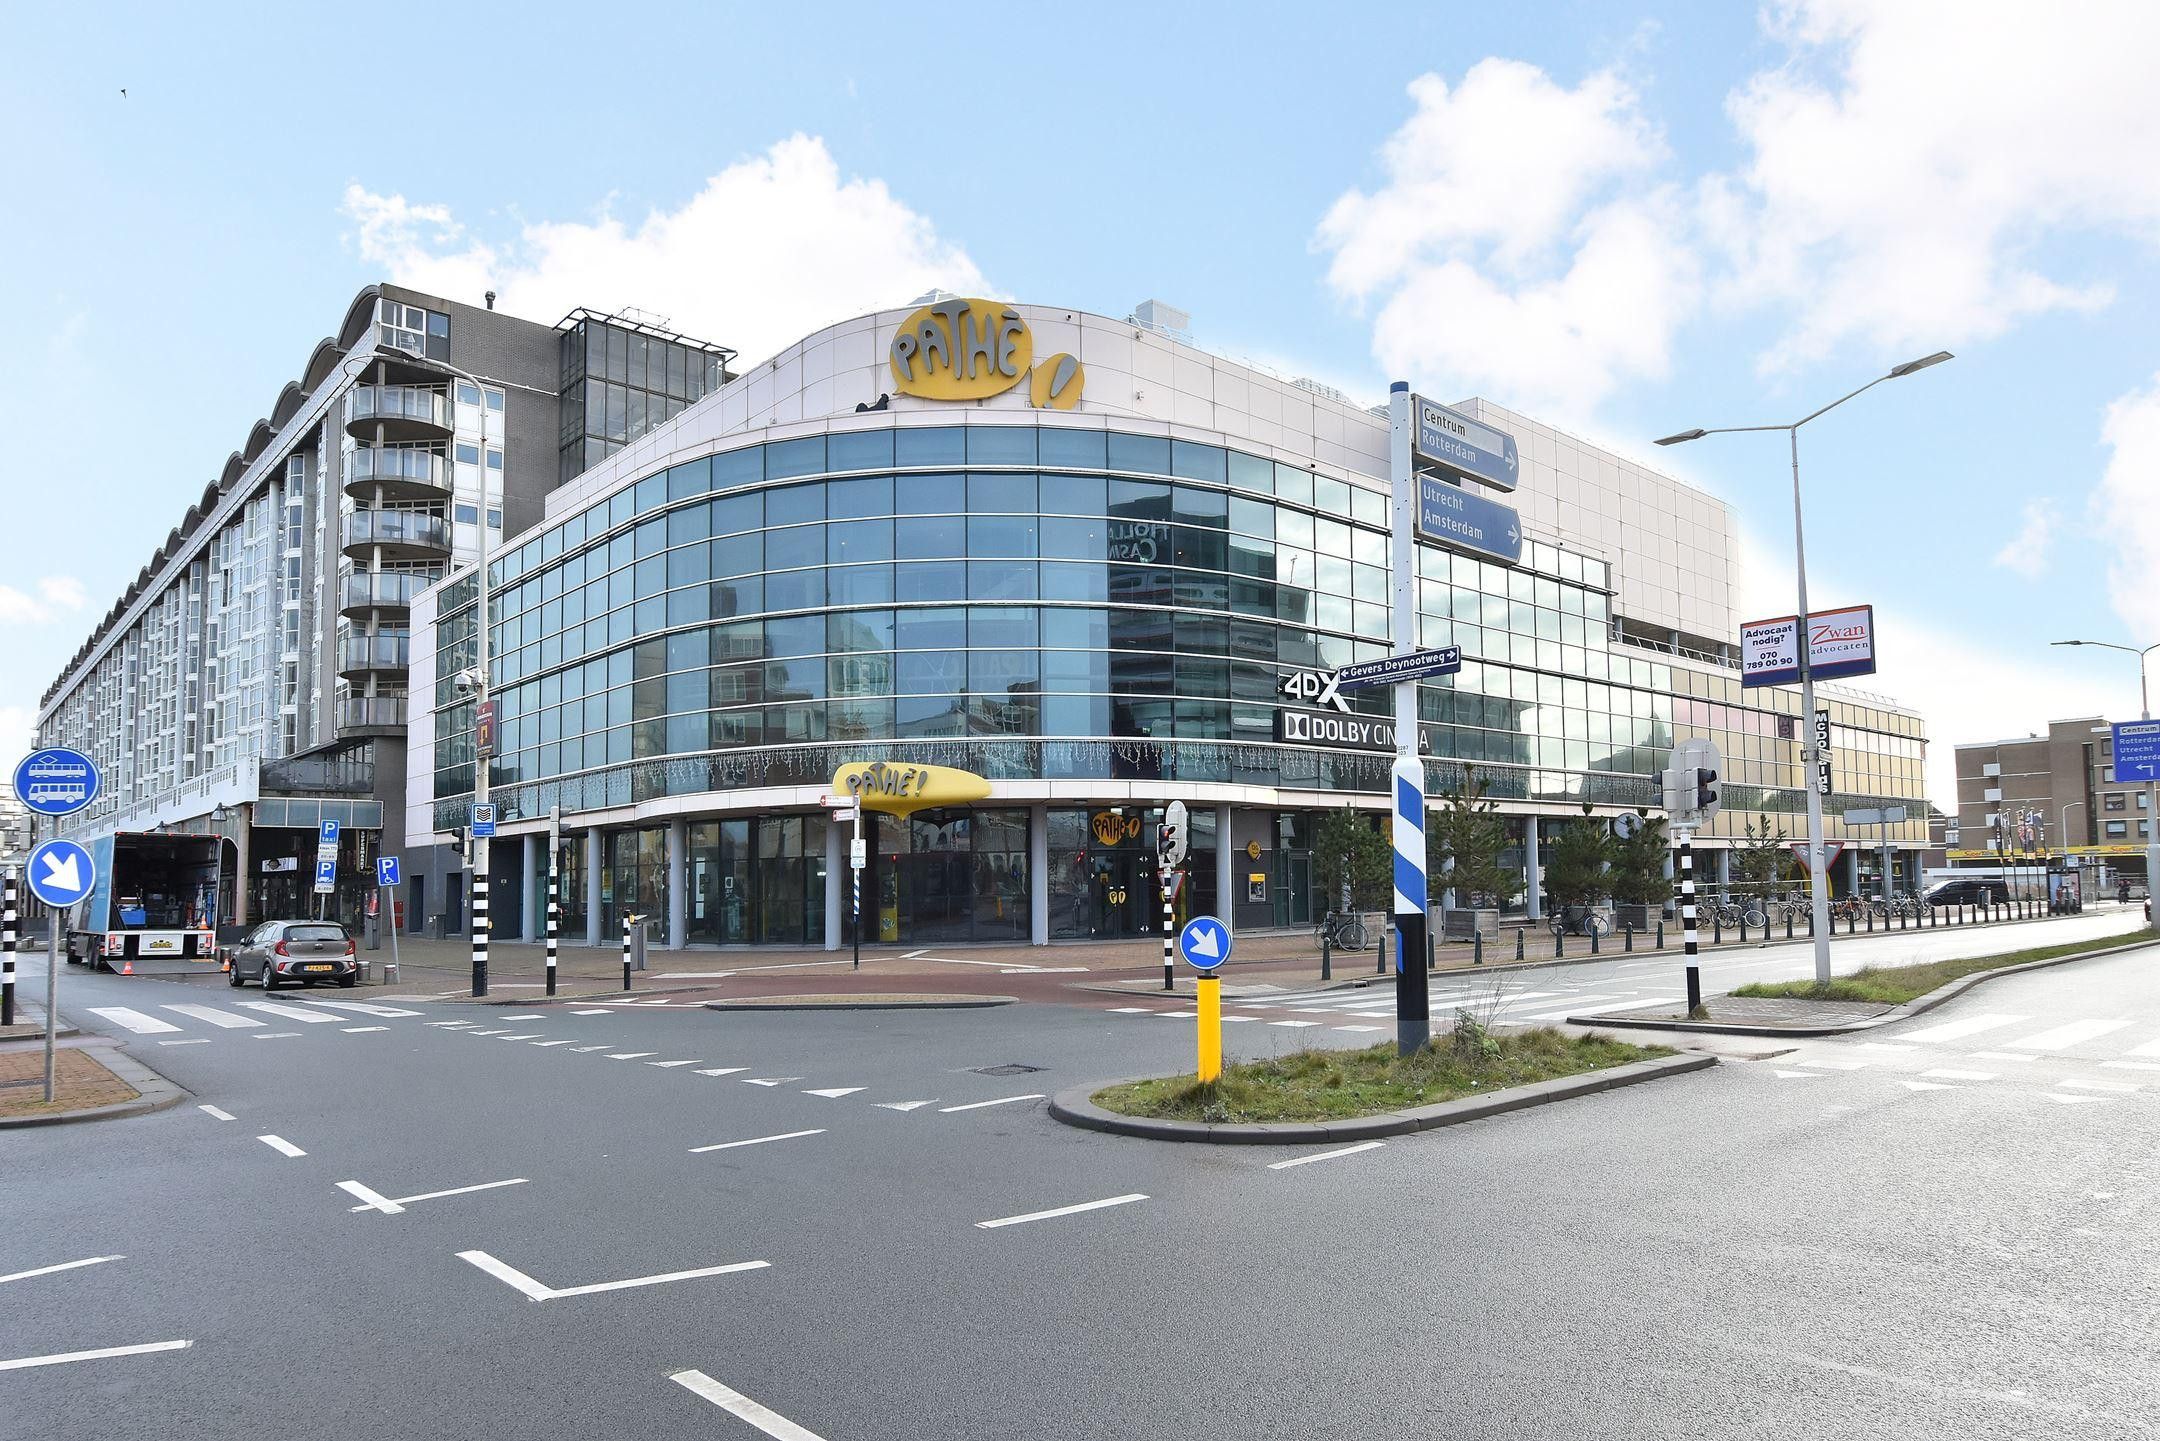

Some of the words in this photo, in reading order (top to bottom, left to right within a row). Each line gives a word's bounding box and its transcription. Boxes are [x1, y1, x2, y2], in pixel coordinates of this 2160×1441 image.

[1424, 407, 1467, 437] Centrum
[1422, 429, 1477, 463] Rotterdam
[1423, 484, 1464, 512] Utrecht
[1424, 508, 1483, 541] Amsterdam
[1745, 624, 1793, 639] Advocaat
[1809, 624, 1867, 645] Zwan
[1752, 634, 1785, 647] nodig?
[1810, 641, 1869, 655] advocaten
[1760, 651, 1778, 660] 070
[1350, 664, 1383, 678] Gevers
[1385, 652, 1446, 671] Deynootweg
[1746, 660, 1764, 670] 789
[1765, 659, 1778, 668] 00
[1780, 657, 1793, 666] 90
[1284, 671, 1352, 713] 4DX
[1312, 718, 1370, 744] DOLBY
[1373, 724, 1430, 749] CINA
[2121, 726, 2157, 734] Centrum
[2119, 746, 2154, 754] Utrecht
[324, 822, 336, 835] P
[320, 862, 332, 875] P
[381, 859, 394, 874] P
